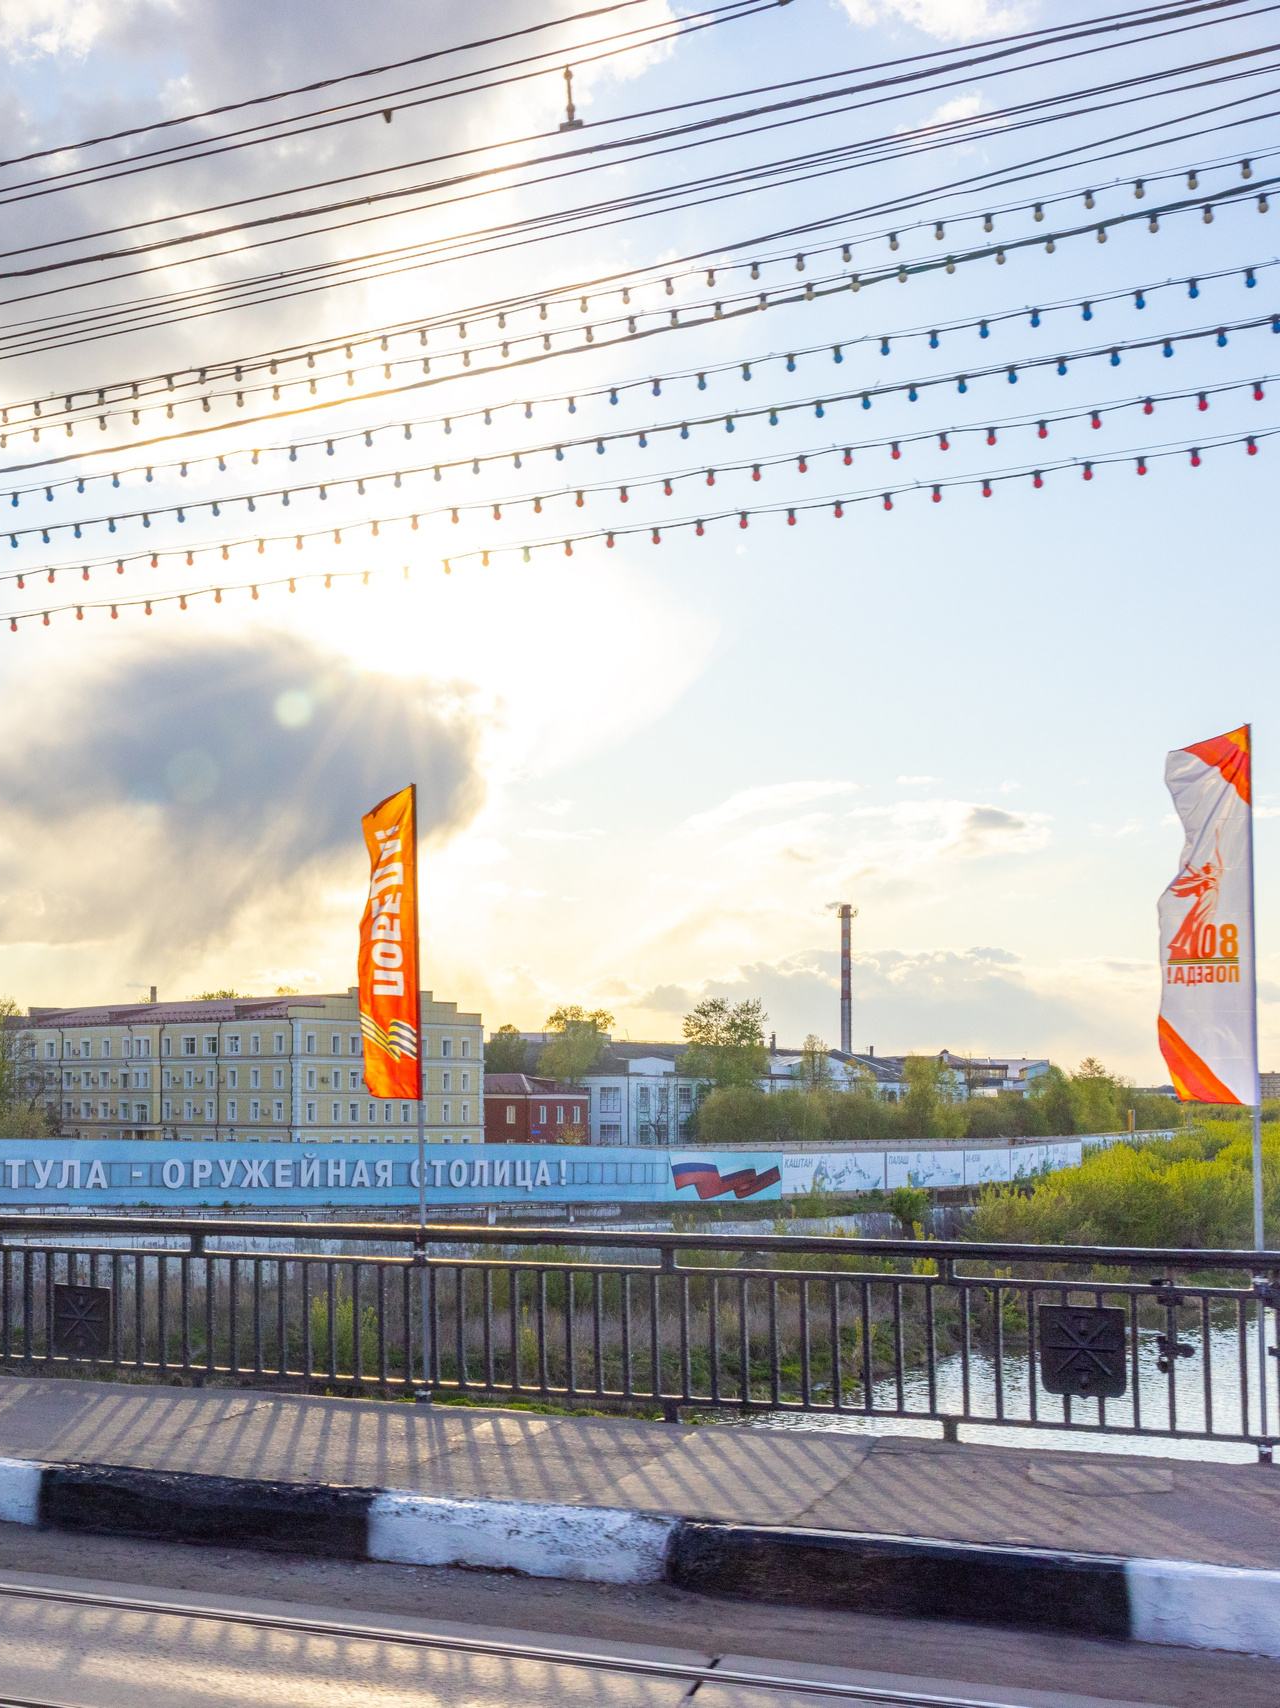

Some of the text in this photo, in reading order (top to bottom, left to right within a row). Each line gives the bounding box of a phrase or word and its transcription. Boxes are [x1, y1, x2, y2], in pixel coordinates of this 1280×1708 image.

[784, 1158, 813, 1168] КАШТАН
[888, 1155, 910, 1165] ПАЛАШ
[4, 1159, 109, 1189] ТУЛА
[162, 1152, 393, 1189] ОРУЖЕЙНАЯ
[410, 1159, 567, 1192] СТОЛИЦА!
